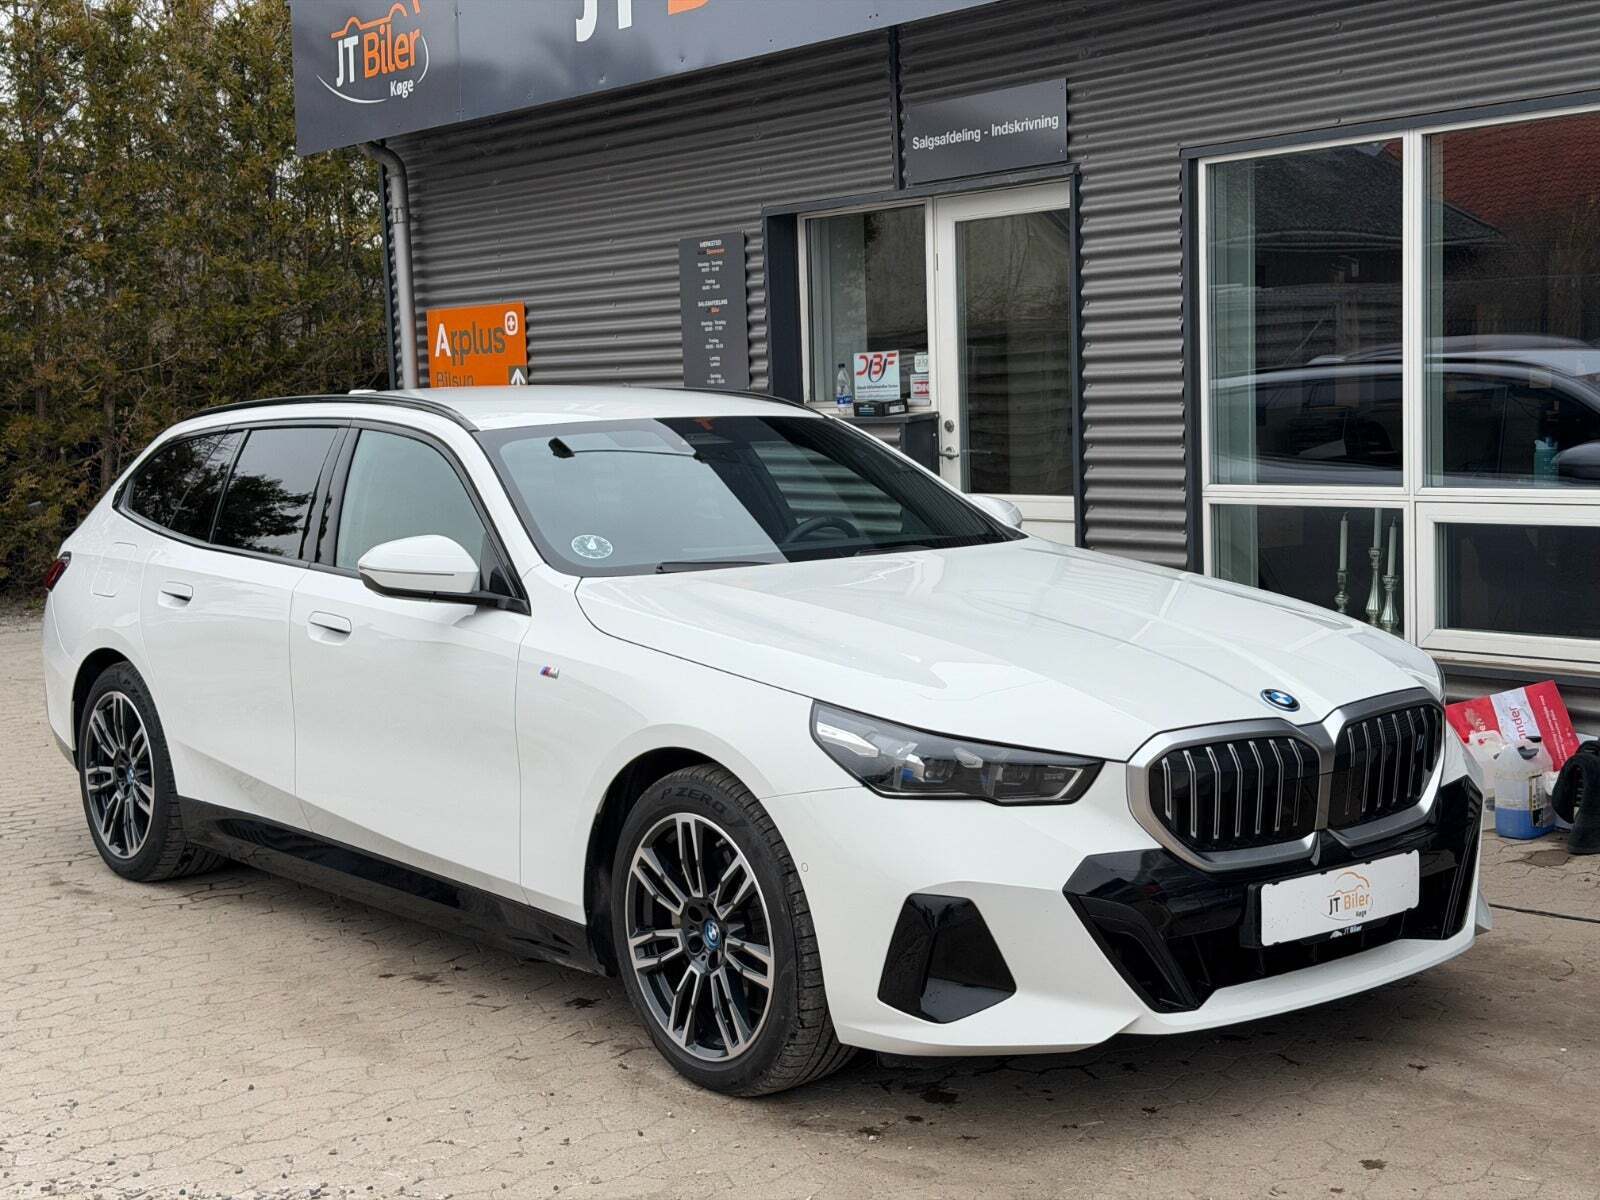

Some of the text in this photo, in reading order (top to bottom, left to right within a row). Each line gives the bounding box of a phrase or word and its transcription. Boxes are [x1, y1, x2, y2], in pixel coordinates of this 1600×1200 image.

[336, 24, 421, 87] JT Biler
[390, 79, 414, 99] Køge
[912, 128, 981, 150] Salgsafdeling
[991, 115, 1059, 137] Indskrivning
[675, 786, 727, 814] ZERO
[1329, 893, 1370, 915] JT Biler
